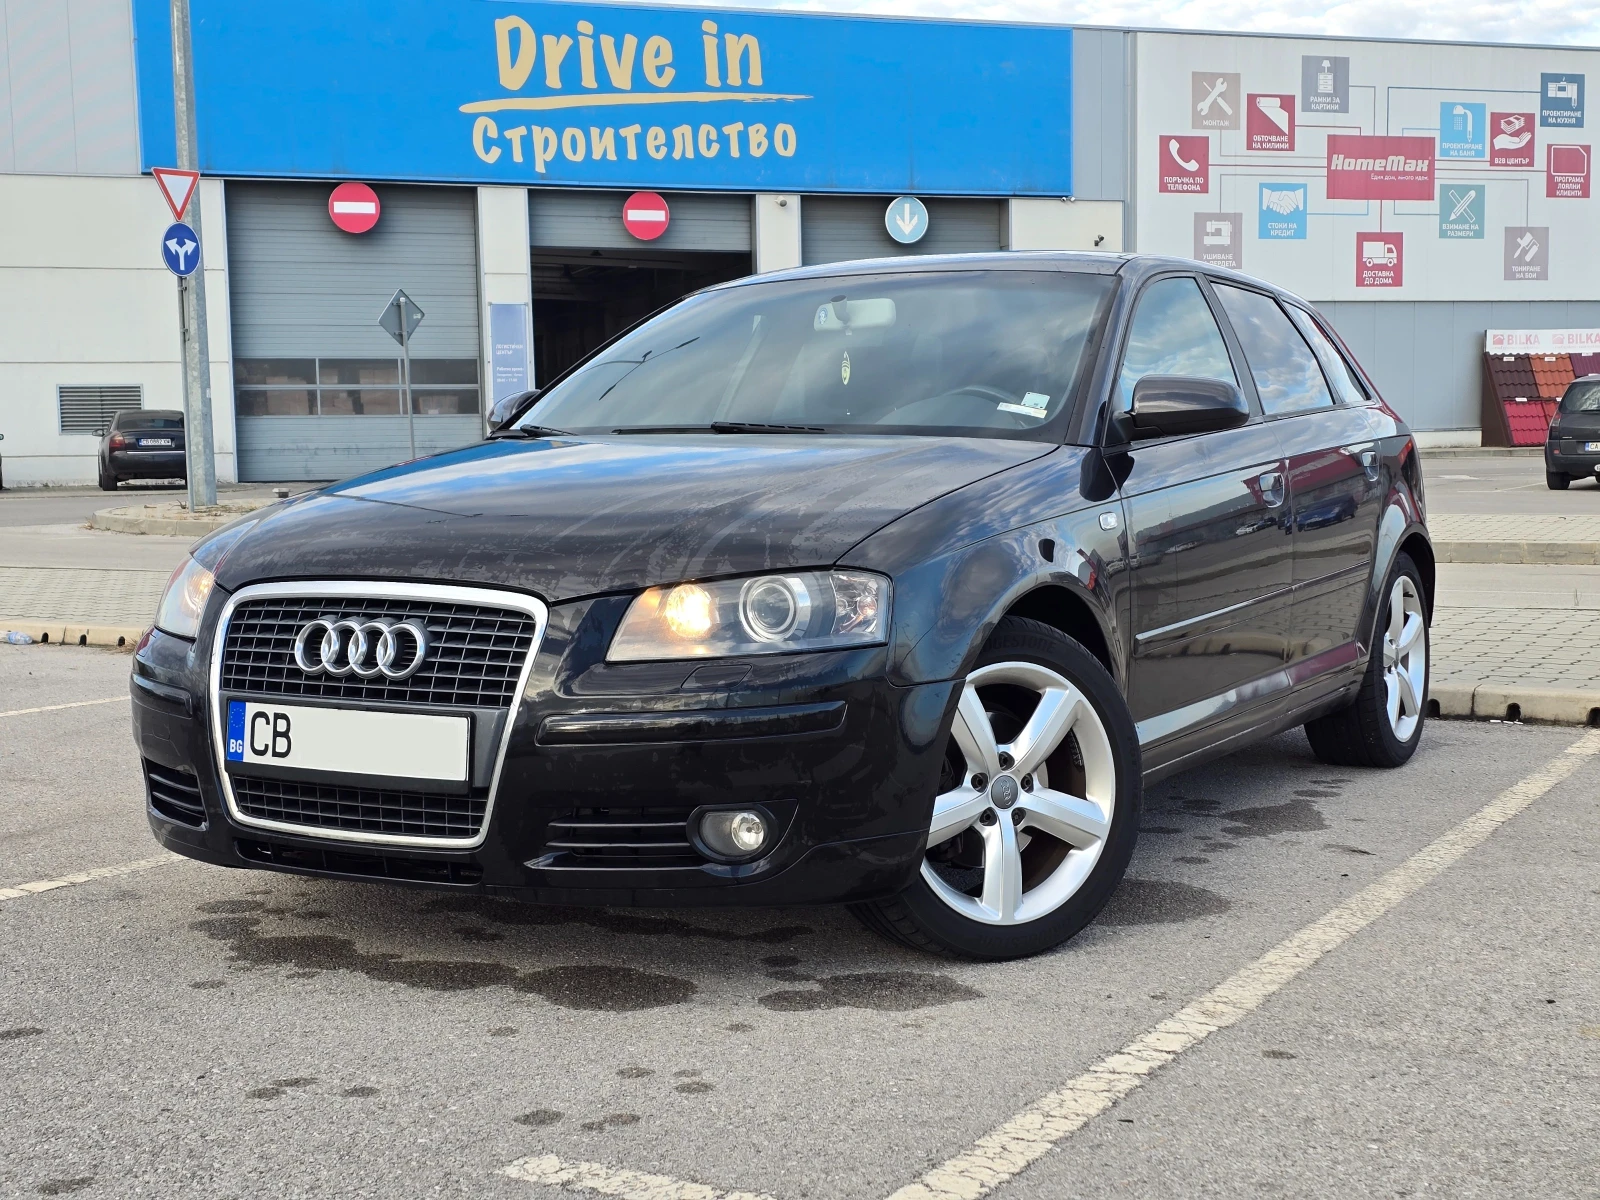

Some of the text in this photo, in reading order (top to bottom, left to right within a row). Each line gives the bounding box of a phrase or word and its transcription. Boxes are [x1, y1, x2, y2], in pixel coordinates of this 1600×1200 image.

[495, 15, 763, 90] Drive in
[472, 116, 797, 173] Строителство
[1331, 154, 1429, 172] HomeMax
[1507, 157, 1530, 165] ЦЕНТЪР
[1507, 334, 1540, 345] BILKA
[250, 711, 291, 758] CB
[230, 739, 243, 749] BG
